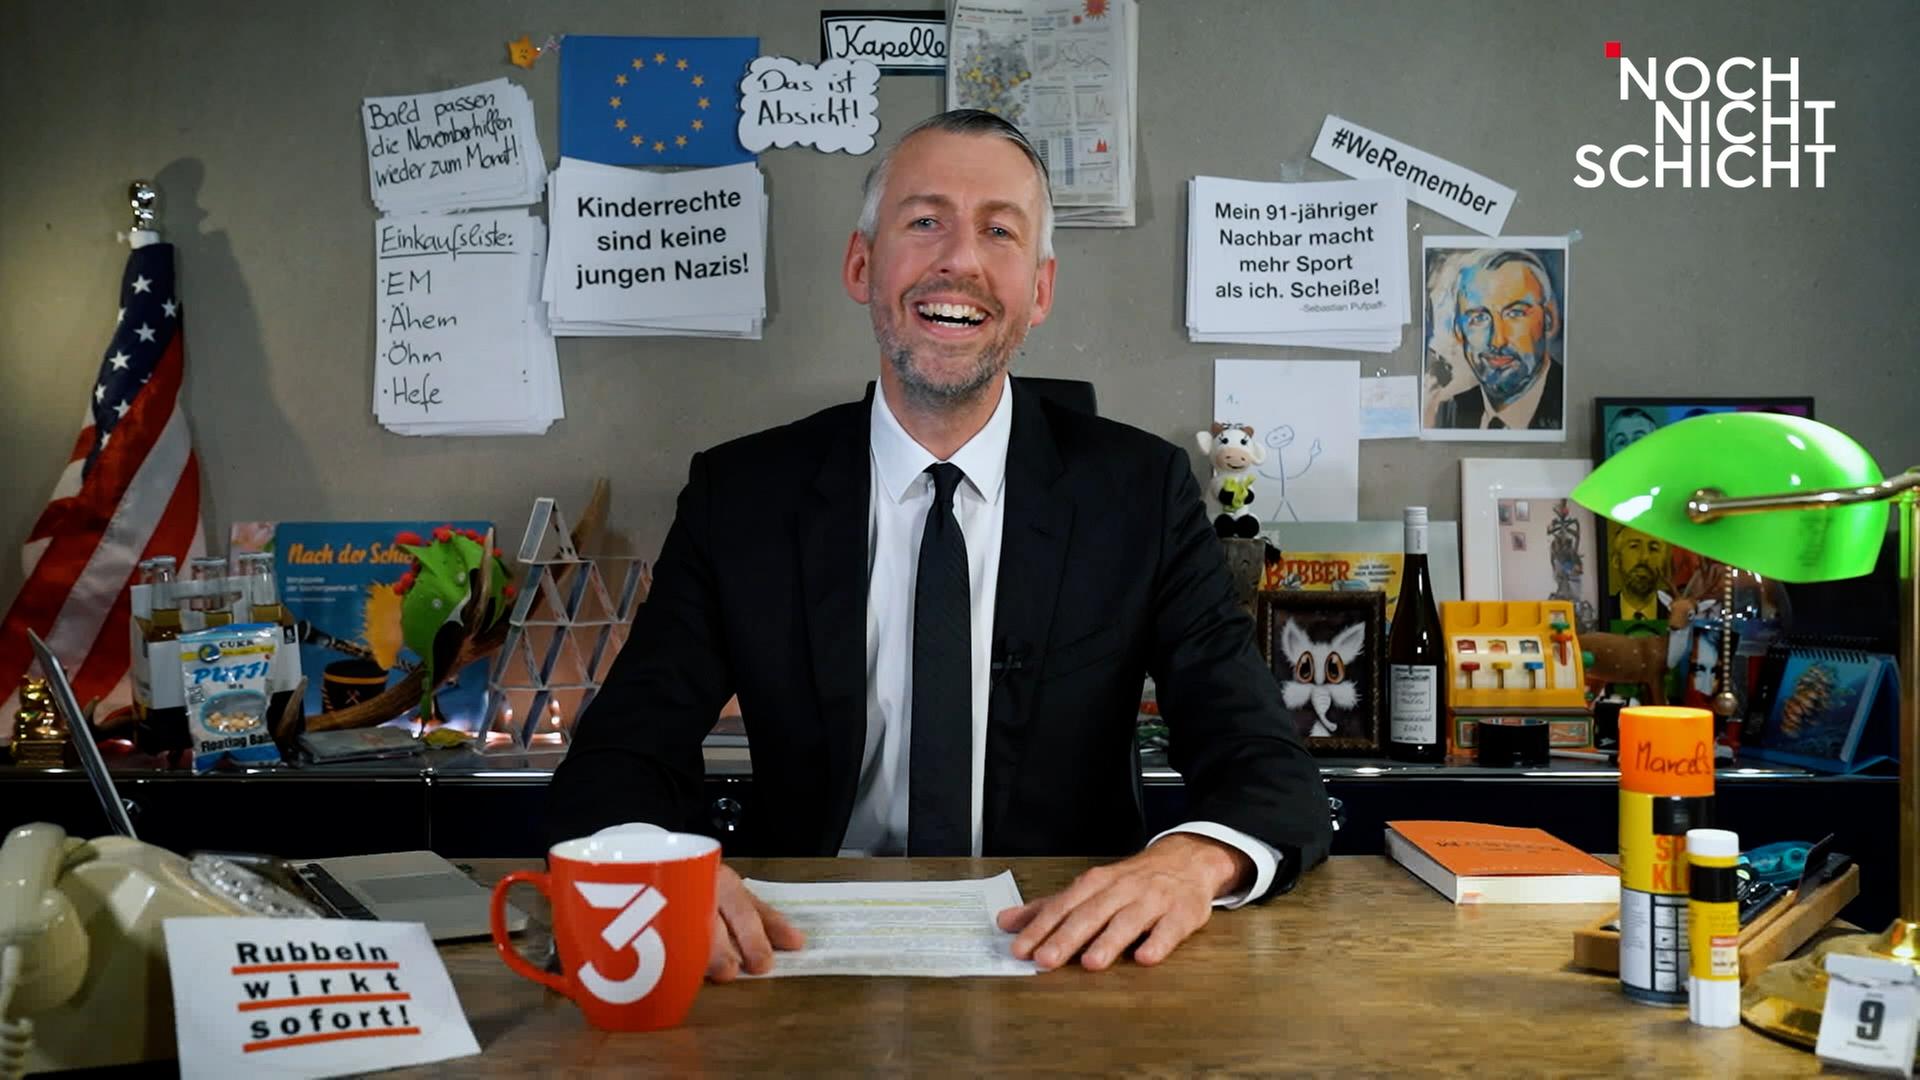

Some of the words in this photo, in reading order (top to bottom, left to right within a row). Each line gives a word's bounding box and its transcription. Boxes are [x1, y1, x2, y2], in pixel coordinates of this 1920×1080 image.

[835, 24, 946, 61] Kapelle
[757, 69, 813, 93] Das
[828, 70, 857, 94] ist
[369, 98, 420, 130] Bald
[434, 92, 495, 126] passen
[757, 97, 859, 128] Absicht!
[371, 134, 400, 157] die
[406, 107, 513, 152] Novemberhilfen
[375, 157, 425, 188] wieder
[428, 157, 462, 179] zum
[466, 133, 520, 170] Monat!
[1331, 126, 1498, 217] #WeRemember
[577, 188, 742, 219] Kinderrechte
[1214, 201, 1260, 220] Mein
[1266, 199, 1378, 224] 91-jähriger
[381, 220, 514, 262] Einkaufsliste:
[597, 228, 651, 252] sind
[660, 225, 727, 249] keine
[1219, 229, 1301, 247] Nachbar
[1308, 225, 1374, 245] macht
[575, 263, 666, 291] jungen
[674, 251, 750, 281] Nazis!
[1239, 256, 1291, 273] mehr
[1295, 252, 1353, 275] Sport
[1215, 281, 1243, 299] als
[1248, 281, 1284, 299] ich.
[1290, 277, 1380, 300] Scheiße!
[389, 302, 457, 333] Ähem
[387, 340, 442, 366] Öhm
[392, 372, 443, 414] Hefe
[287, 543, 334, 566] Nach
[337, 543, 367, 565] der
[1264, 560, 1350, 591] BIBBER
[236, 942, 389, 964] Rubbeln
[572, 880, 669, 1006] 3
[244, 972, 400, 1000] wirkt
[250, 1005, 410, 1040] sofort!
[1855, 1000, 1886, 1041] 9
